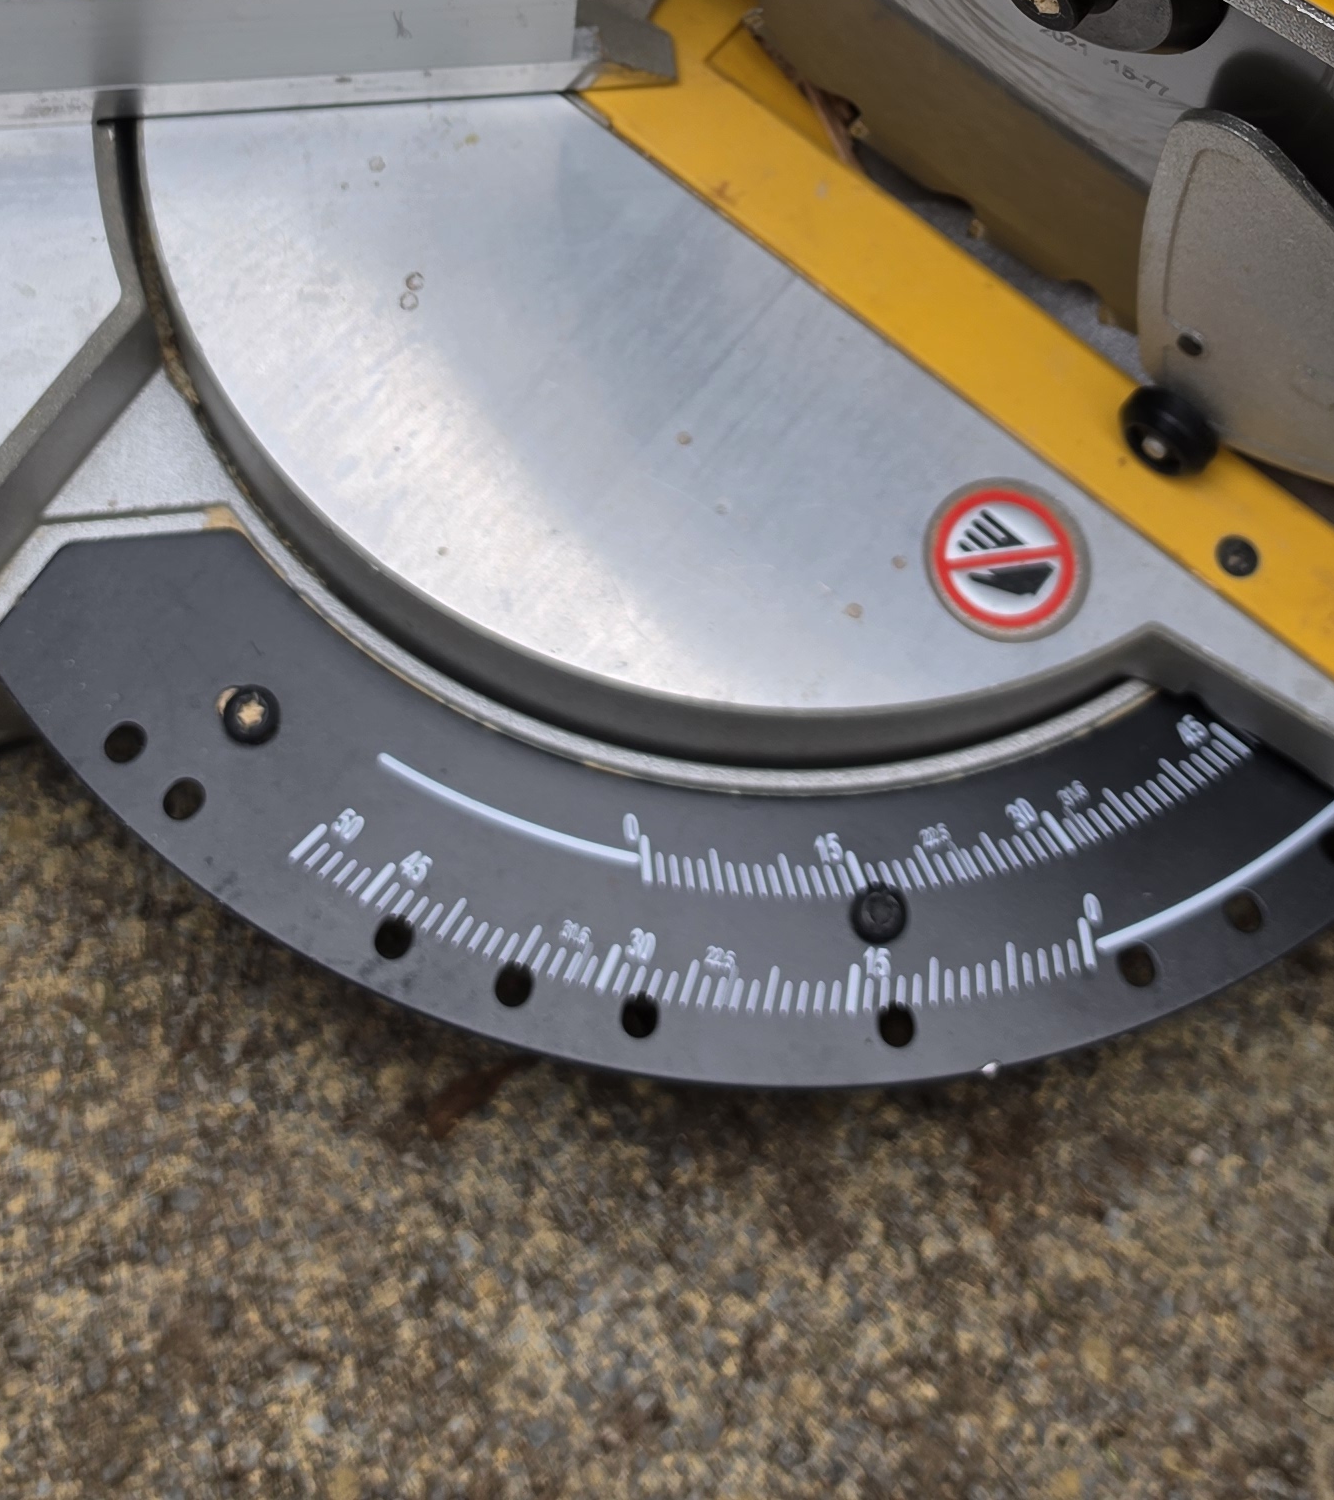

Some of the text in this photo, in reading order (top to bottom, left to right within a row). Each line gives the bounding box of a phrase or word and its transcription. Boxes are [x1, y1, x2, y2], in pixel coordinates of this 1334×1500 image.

[622, 812, 641, 846] 0
[814, 831, 844, 865] 15
[1004, 797, 1038, 833] 30
[1175, 713, 1212, 751] 45
[331, 807, 365, 844] 50
[399, 850, 434, 886] 45
[624, 927, 657, 965] 30
[862, 945, 892, 981] 15
[1082, 891, 1104, 929] 0
